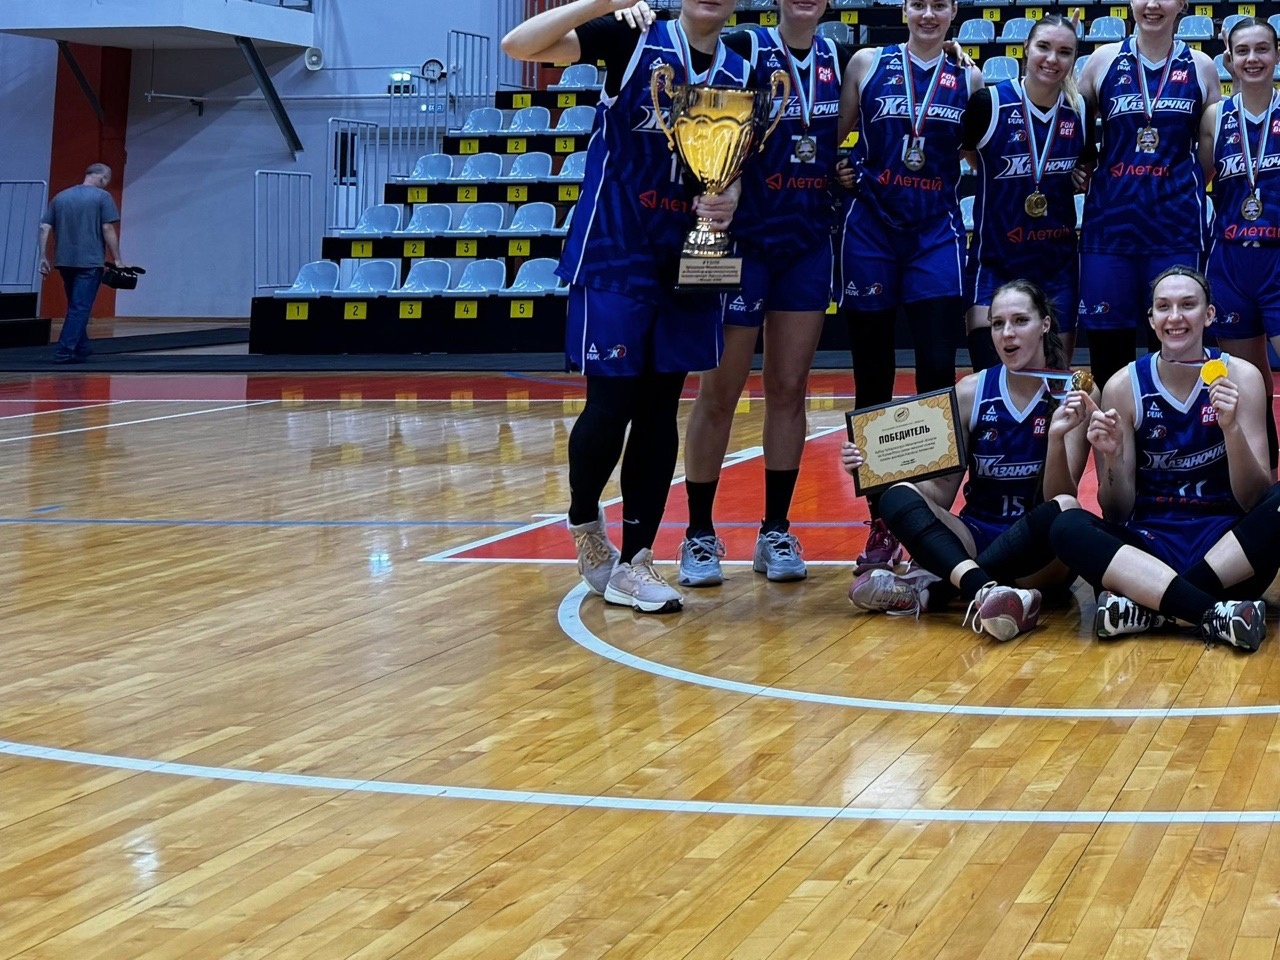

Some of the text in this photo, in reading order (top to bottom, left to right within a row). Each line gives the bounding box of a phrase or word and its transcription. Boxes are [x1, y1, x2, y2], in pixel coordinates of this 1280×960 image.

[989, 10, 995, 18] 8
[941, 72, 956, 80] FON
[940, 79, 956, 87] BET
[1222, 83, 1232, 93] 14
[564, 96, 570, 105] 2
[1008, 117, 1024, 125] PEAK
[1060, 128, 1074, 136] BET
[514, 141, 520, 151] 2
[562, 140, 568, 150] 3
[464, 190, 471, 200] 2
[514, 189, 520, 199] 3
[565, 188, 572, 198] 4
[411, 244, 418, 254] 2
[463, 243, 470, 254] 3
[516, 242, 523, 253] 4
[352, 304, 359, 316] 2
[407, 304, 414, 315] 3
[463, 303, 470, 315] 4
[519, 303, 525, 315] 5
[729, 304, 747, 312] PEAK
[1202, 406, 1215, 415] FO
[1034, 418, 1046, 426] FO
[878, 425, 931, 445] ПОБЕДИТЕЛЬ
[1033, 426, 1045, 434] BE
[1151, 444, 1226, 469] КАЗАНОЧК
[1002, 495, 1025, 516] 15
